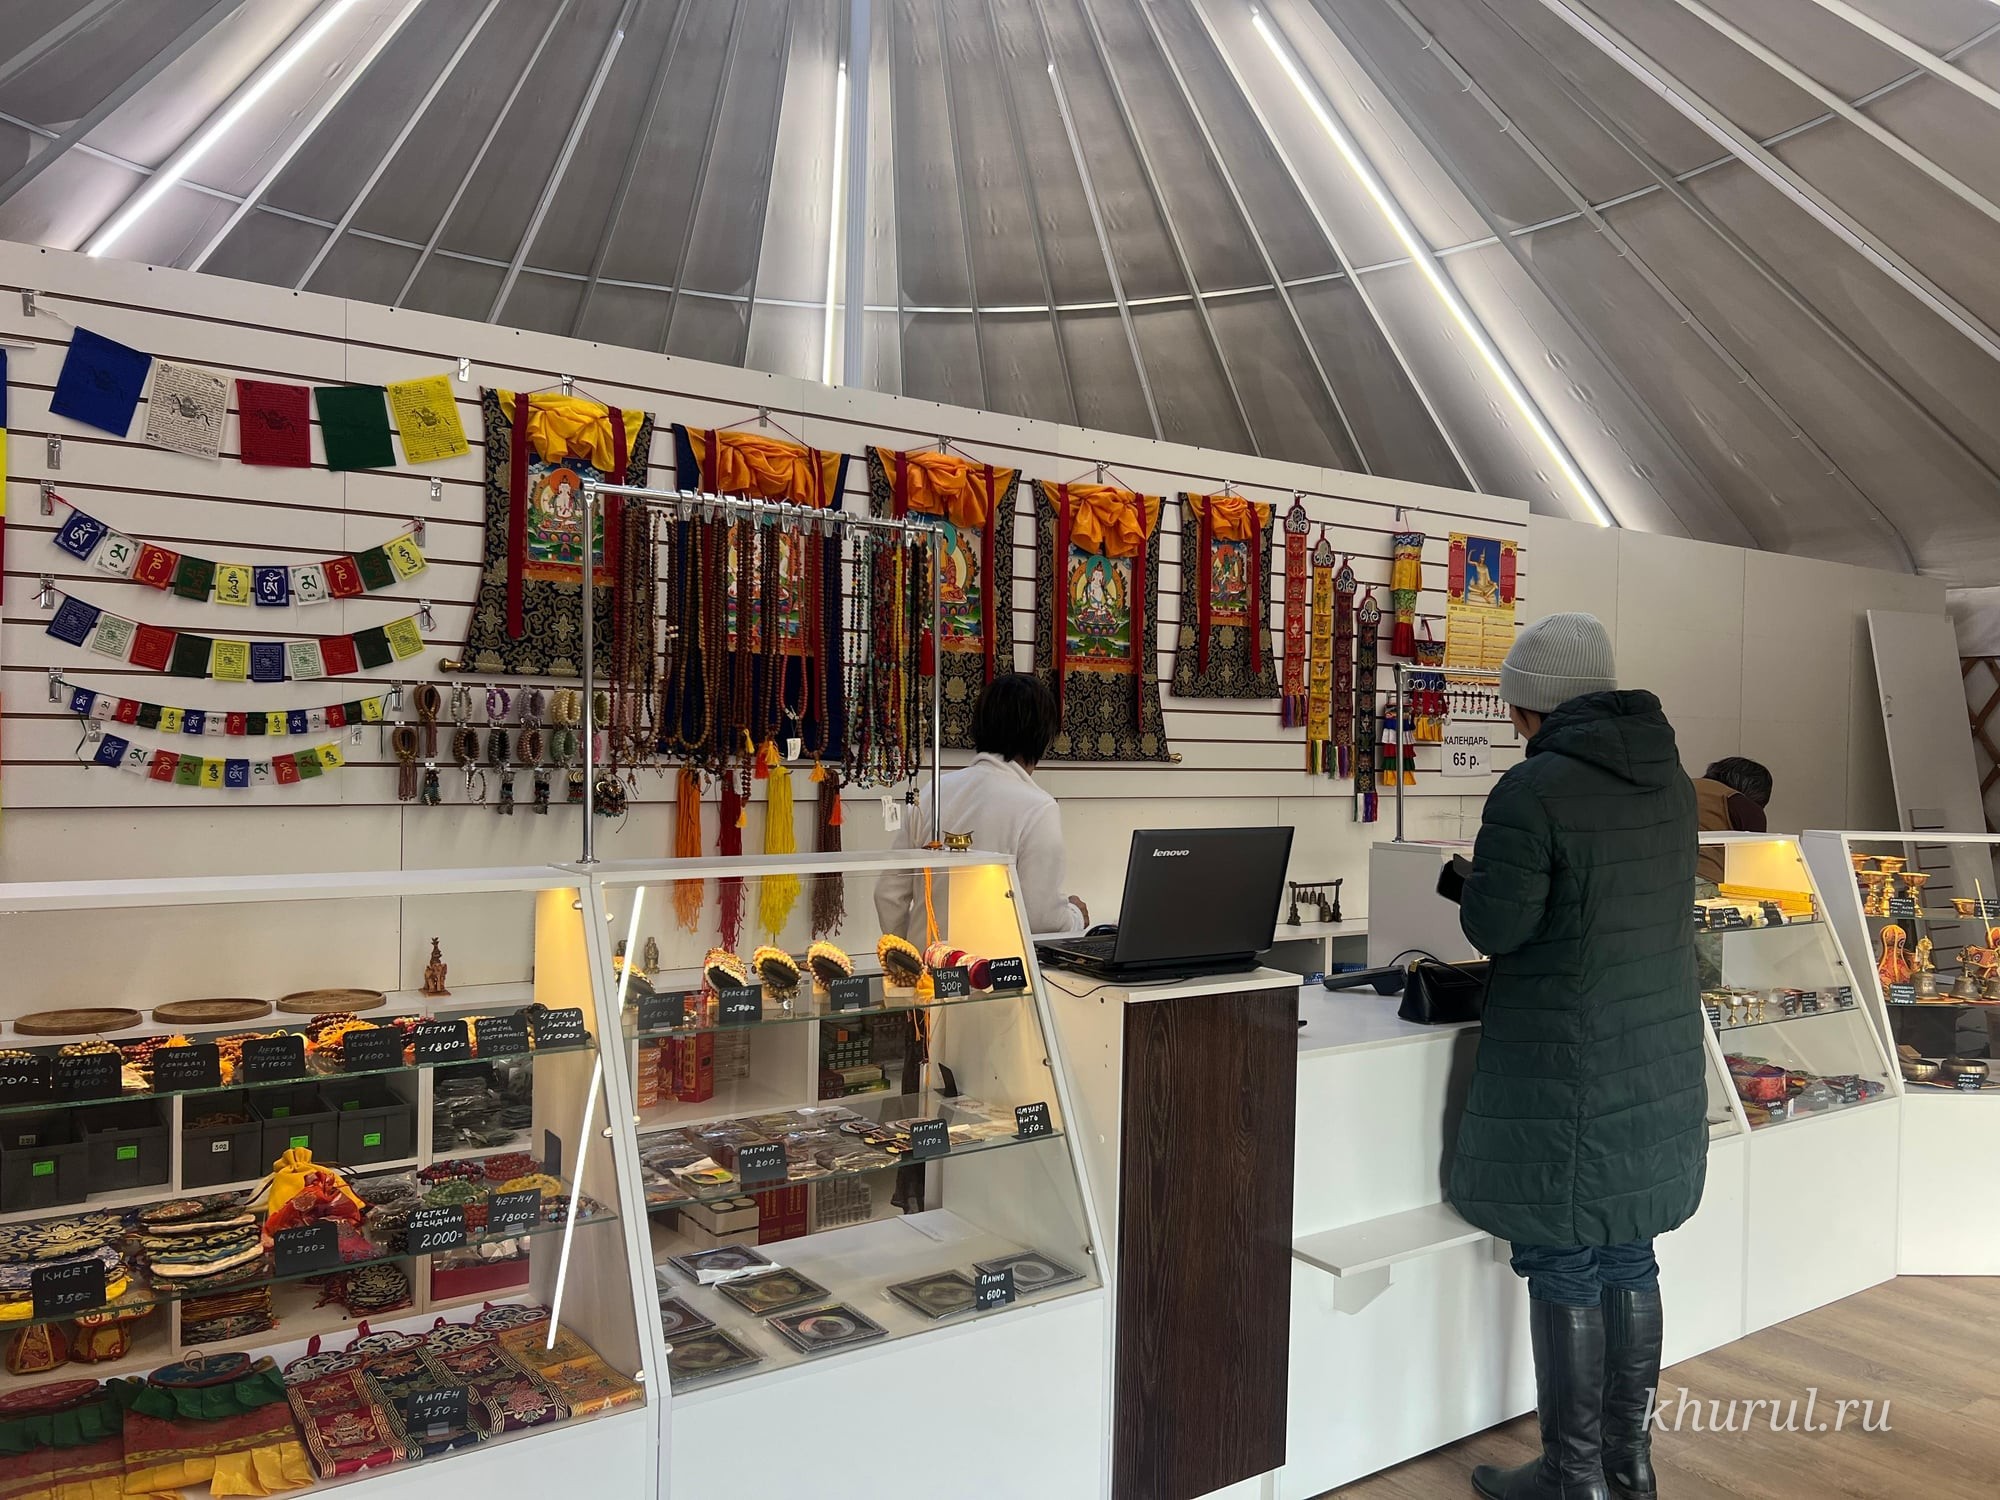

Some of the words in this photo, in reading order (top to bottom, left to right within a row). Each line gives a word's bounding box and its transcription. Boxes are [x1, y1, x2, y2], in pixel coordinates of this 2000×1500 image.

[1444, 736, 1488, 746] КАЛЕНДАРЬ
[1453, 752, 1466, 766] 65
[1469, 755, 1480, 769] р.
[1152, 848, 1190, 857] lenovo
[936, 970, 960, 980] ЧЕТКИ
[540, 1010, 577, 1020] ЧЕТКИ
[416, 1025, 456, 1036] ЧЕТКИ
[420, 1040, 465, 1053] =1800=
[913, 1122, 944, 1132] МАГНИТ
[740, 1144, 779, 1156] МАГНИТ
[496, 1194, 534, 1206] ЧЕТКИ
[415, 1208, 450, 1219] ЧЕТКИ
[493, 1212, 536, 1223] =1800=
[277, 1228, 321, 1242] КИСЕТ
[420, 1230, 463, 1249] 2000=
[42, 1265, 94, 1281] КИСЕТ
[981, 1273, 1005, 1285] ПАННО
[416, 1390, 460, 1404] КАПЕН
[413, 1406, 459, 1419] =750=
